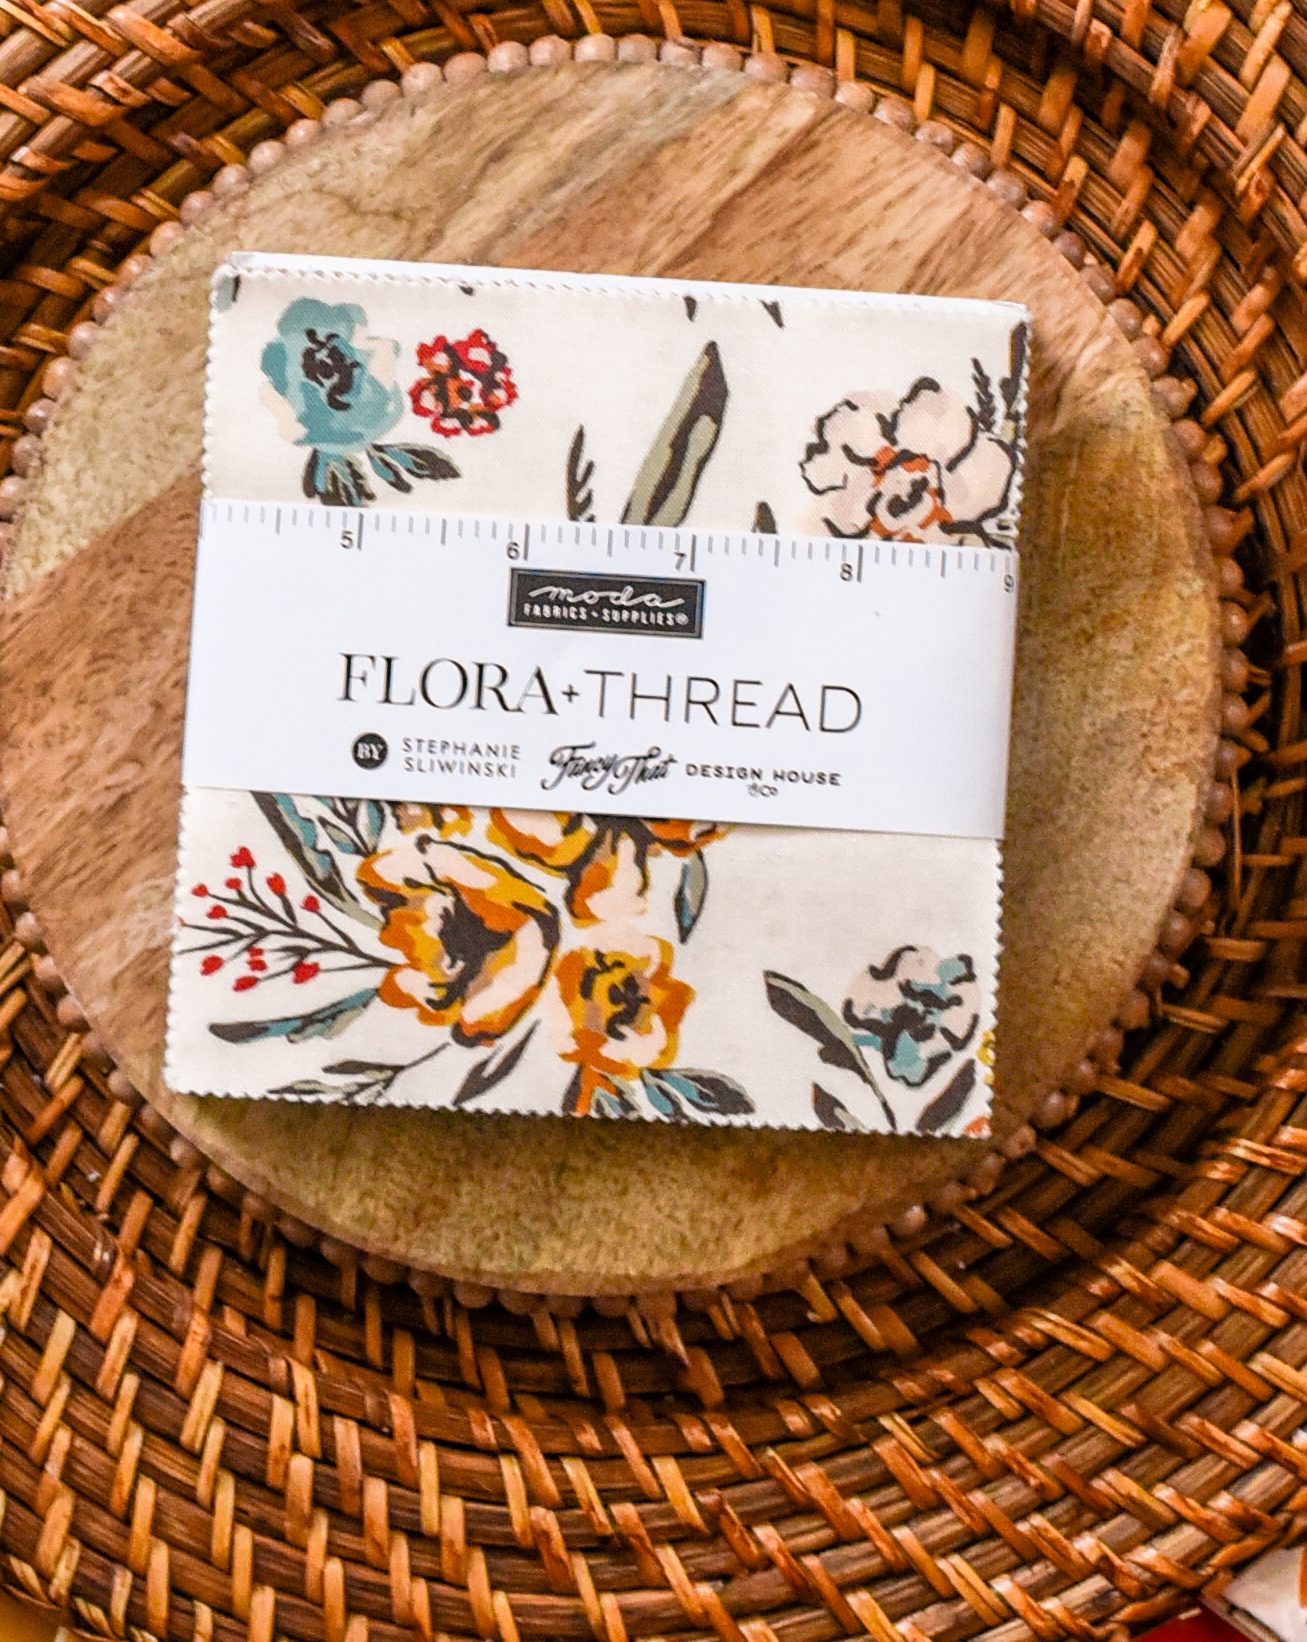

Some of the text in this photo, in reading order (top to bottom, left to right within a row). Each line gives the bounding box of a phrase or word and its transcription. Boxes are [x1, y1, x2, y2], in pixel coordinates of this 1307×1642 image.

[340, 530, 1015, 594] 5 6 7 8 9
[528, 585, 685, 608] moda
[523, 603, 588, 621] FABRICS
[355, 743, 385, 761] BY
[402, 737, 522, 760] STEPHANIE
[403, 757, 517, 778] SLIWINSKI
[540, 740, 842, 795] Fancy That DESIGN HOUSE
